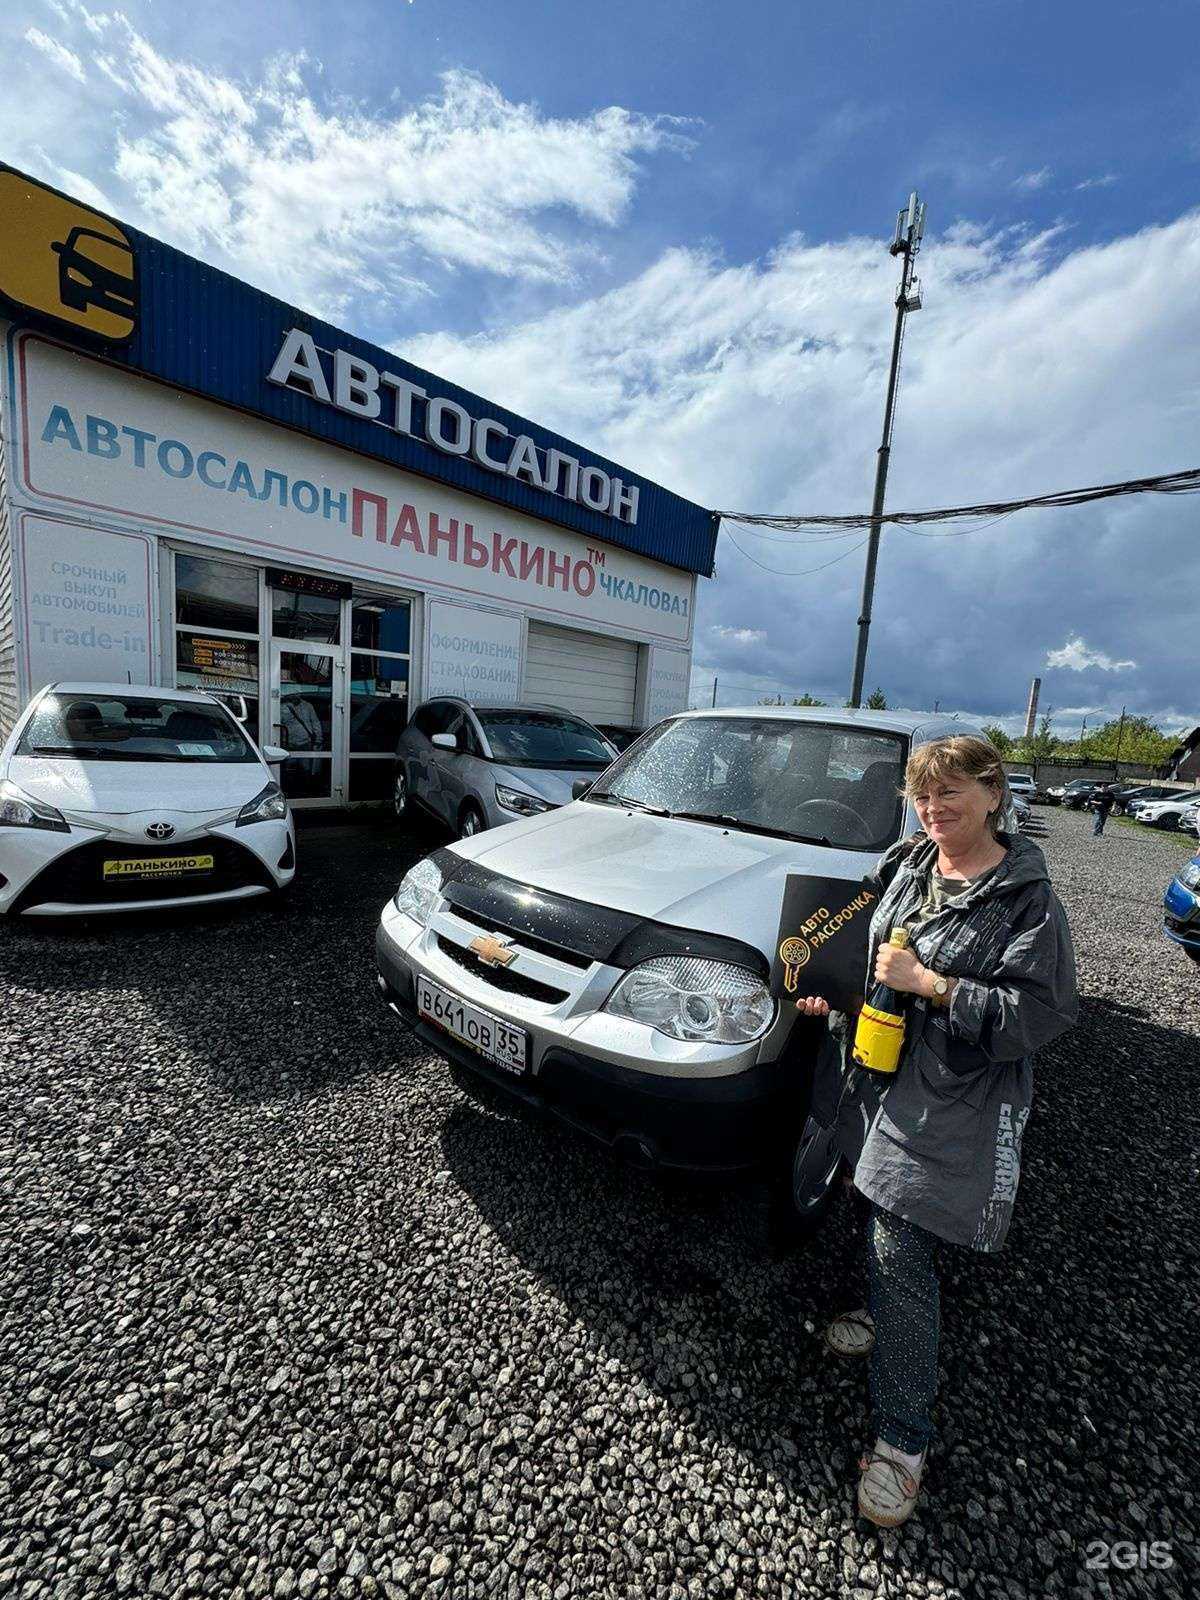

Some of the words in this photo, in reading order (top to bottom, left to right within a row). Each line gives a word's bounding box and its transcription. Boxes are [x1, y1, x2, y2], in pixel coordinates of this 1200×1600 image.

[267, 327, 640, 525] АВТОСАЛОН
[41, 405, 348, 523] АВТОСАЛОН
[351, 487, 596, 597] ПАНЬКИНО
[51, 561, 127, 585] СРОЧНЫЙ
[64, 580, 117, 599] ВЫКУП
[33, 592, 145, 619] АВТОМОБИЛЕЙ
[33, 620, 146, 653] Trade-in
[432, 633, 520, 660] ОФОРМЛЕНИЕ
[432, 661, 517, 684] СТРАХОВАНИЕ
[124, 859, 197, 872] ПАНЬКИНО
[800, 907, 830, 937] АВТО
[810, 890, 875, 948] РАССРОЧКА
[497, 1026, 519, 1055] 35
